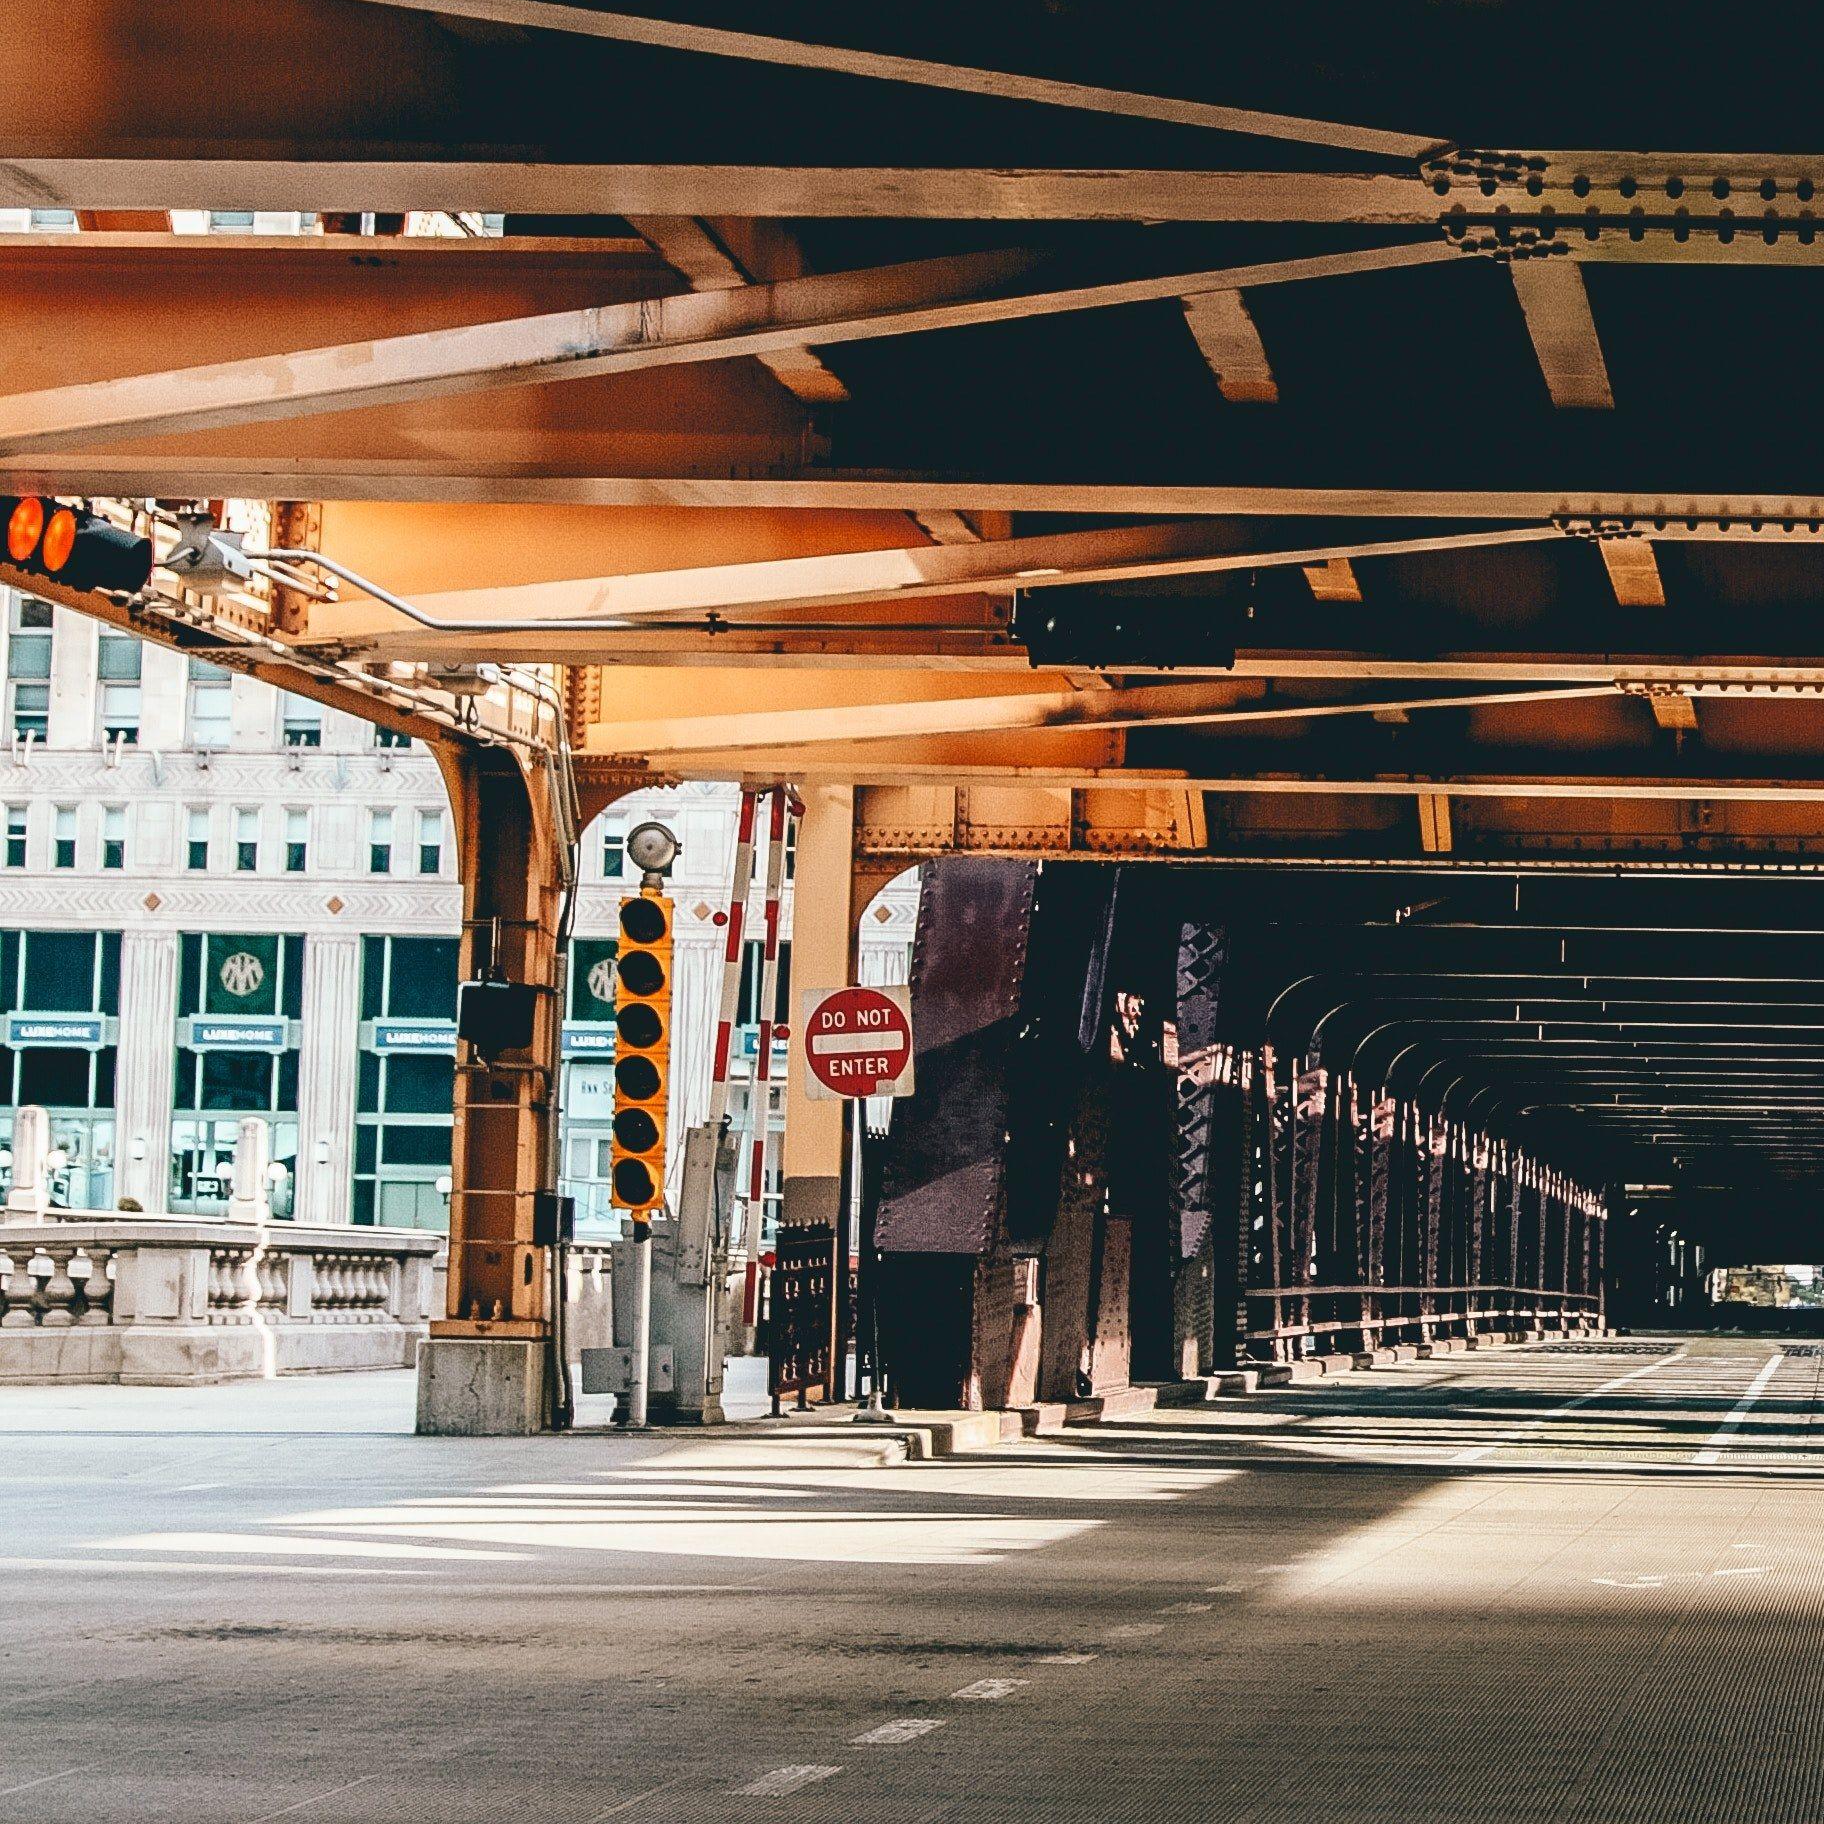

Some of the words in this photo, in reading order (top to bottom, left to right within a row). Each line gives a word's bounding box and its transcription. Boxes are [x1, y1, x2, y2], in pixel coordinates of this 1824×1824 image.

[822, 1011, 846, 1029] DO
[856, 1009, 891, 1026] NOT
[829, 1057, 889, 1076] ENTER
